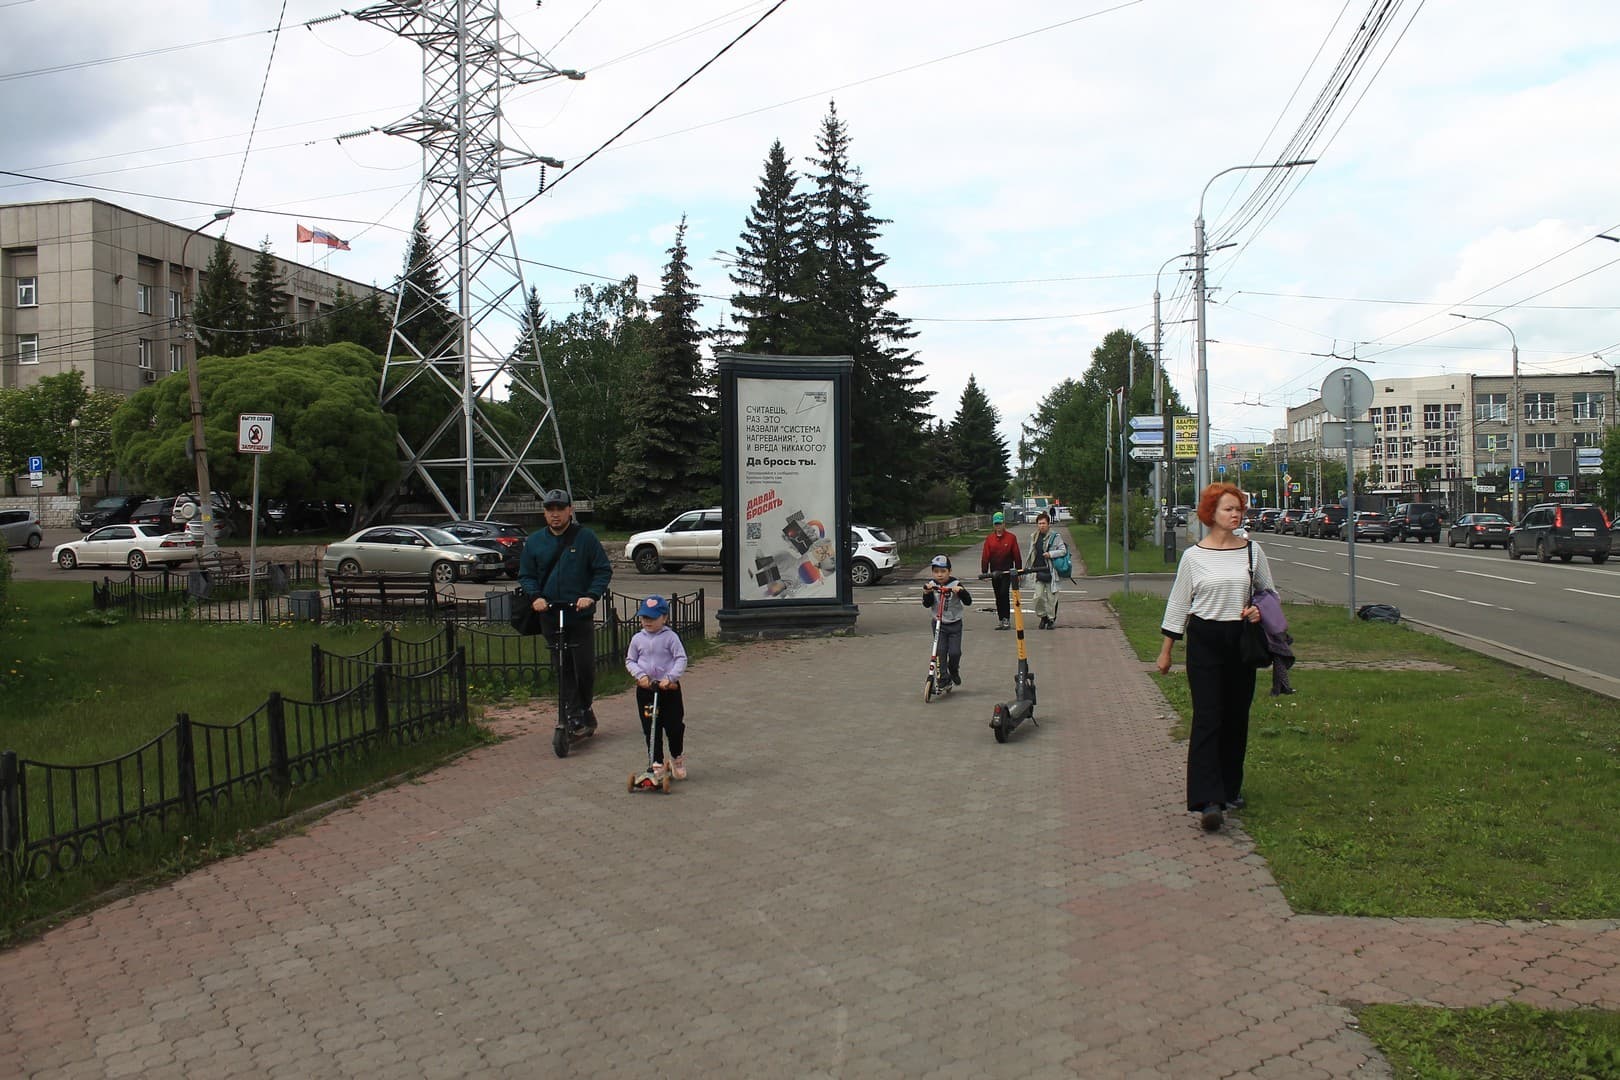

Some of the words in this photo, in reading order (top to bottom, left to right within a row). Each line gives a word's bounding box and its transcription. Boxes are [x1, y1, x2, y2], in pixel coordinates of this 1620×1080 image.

[746, 405, 788, 415] СЧИТАЕШЬ,
[746, 415, 760, 423] РАЗ
[763, 415, 781, 423] ЭТО
[746, 425, 779, 433] НАЗВАЛИ
[781, 425, 821, 433] "СИСТЕМА
[801, 435, 813, 443] ТО
[754, 444, 778, 453] ВРЕДА
[781, 444, 827, 452] НИКАКОГО?
[746, 457, 762, 467] Да
[763, 457, 797, 468] брось
[746, 488, 775, 511] ДАВАЙ
[746, 498, 783, 520] БРОСАТЬ
